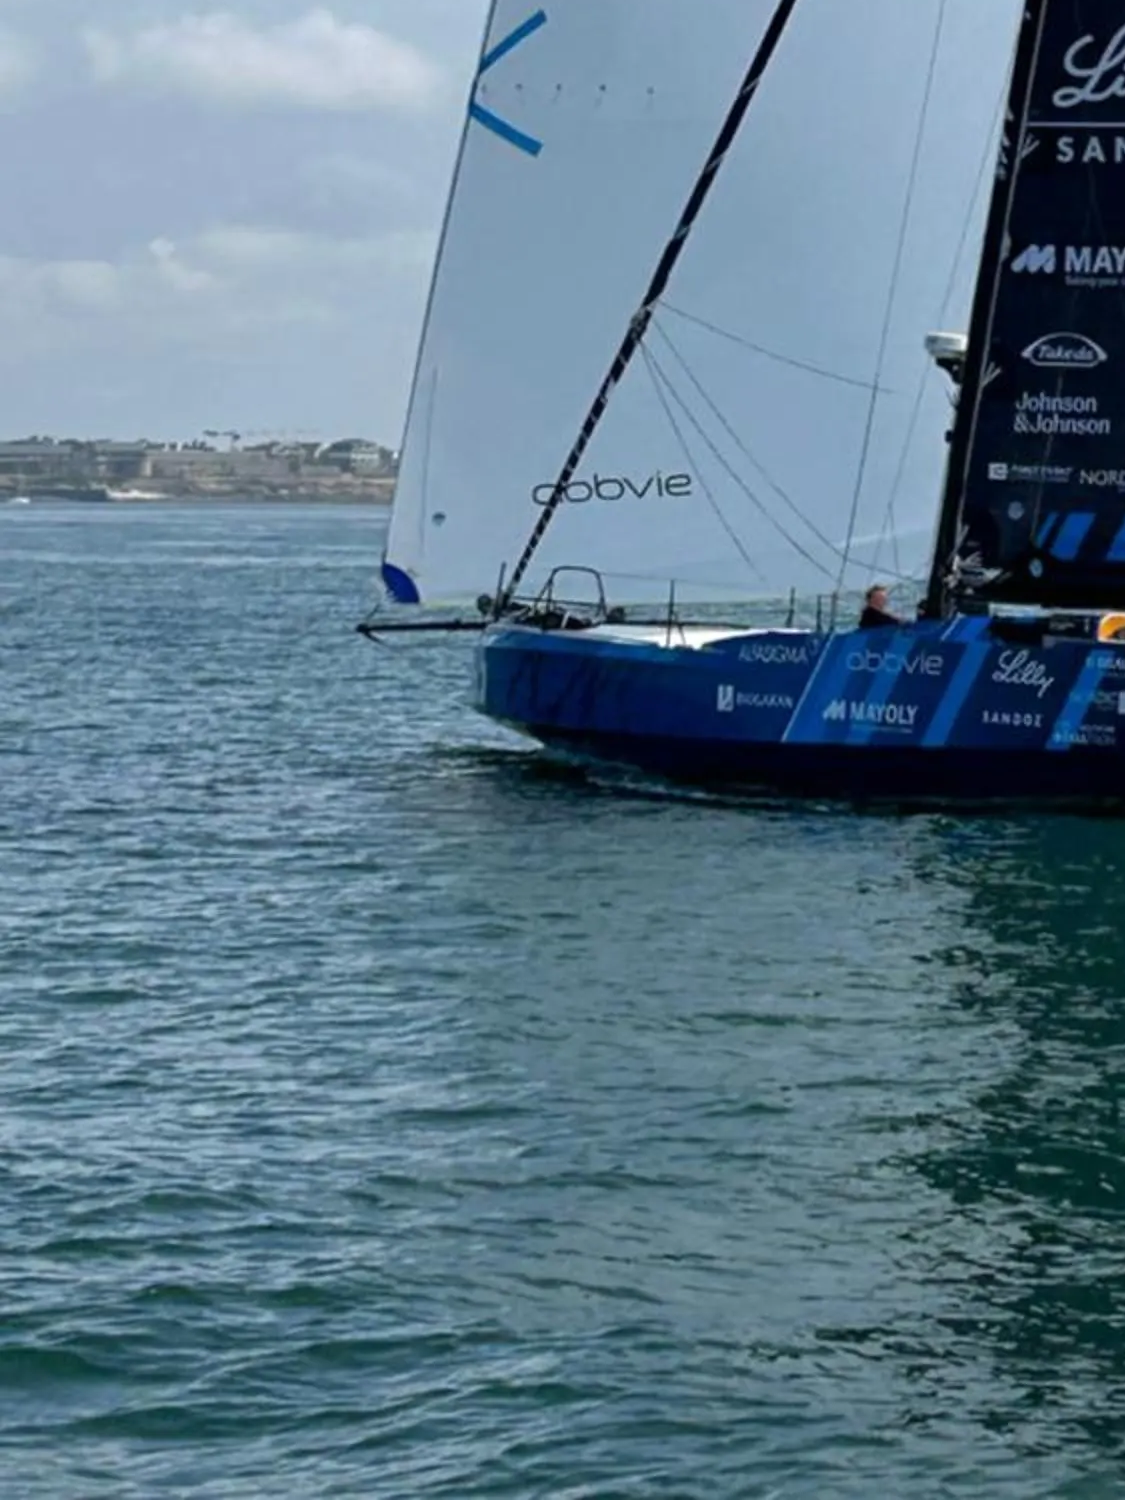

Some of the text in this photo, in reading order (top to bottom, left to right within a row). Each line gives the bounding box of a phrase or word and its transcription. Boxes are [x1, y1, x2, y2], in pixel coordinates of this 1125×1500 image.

[1037, 344, 1094, 360] Takeda
[1015, 390, 1098, 413] Johnson
[532, 469, 692, 506] abbvie
[845, 649, 944, 676] abbvie
[991, 649, 1055, 699] Lilly
[849, 701, 919, 725] MAYOLY
[982, 709, 1044, 728] SANDOZ
